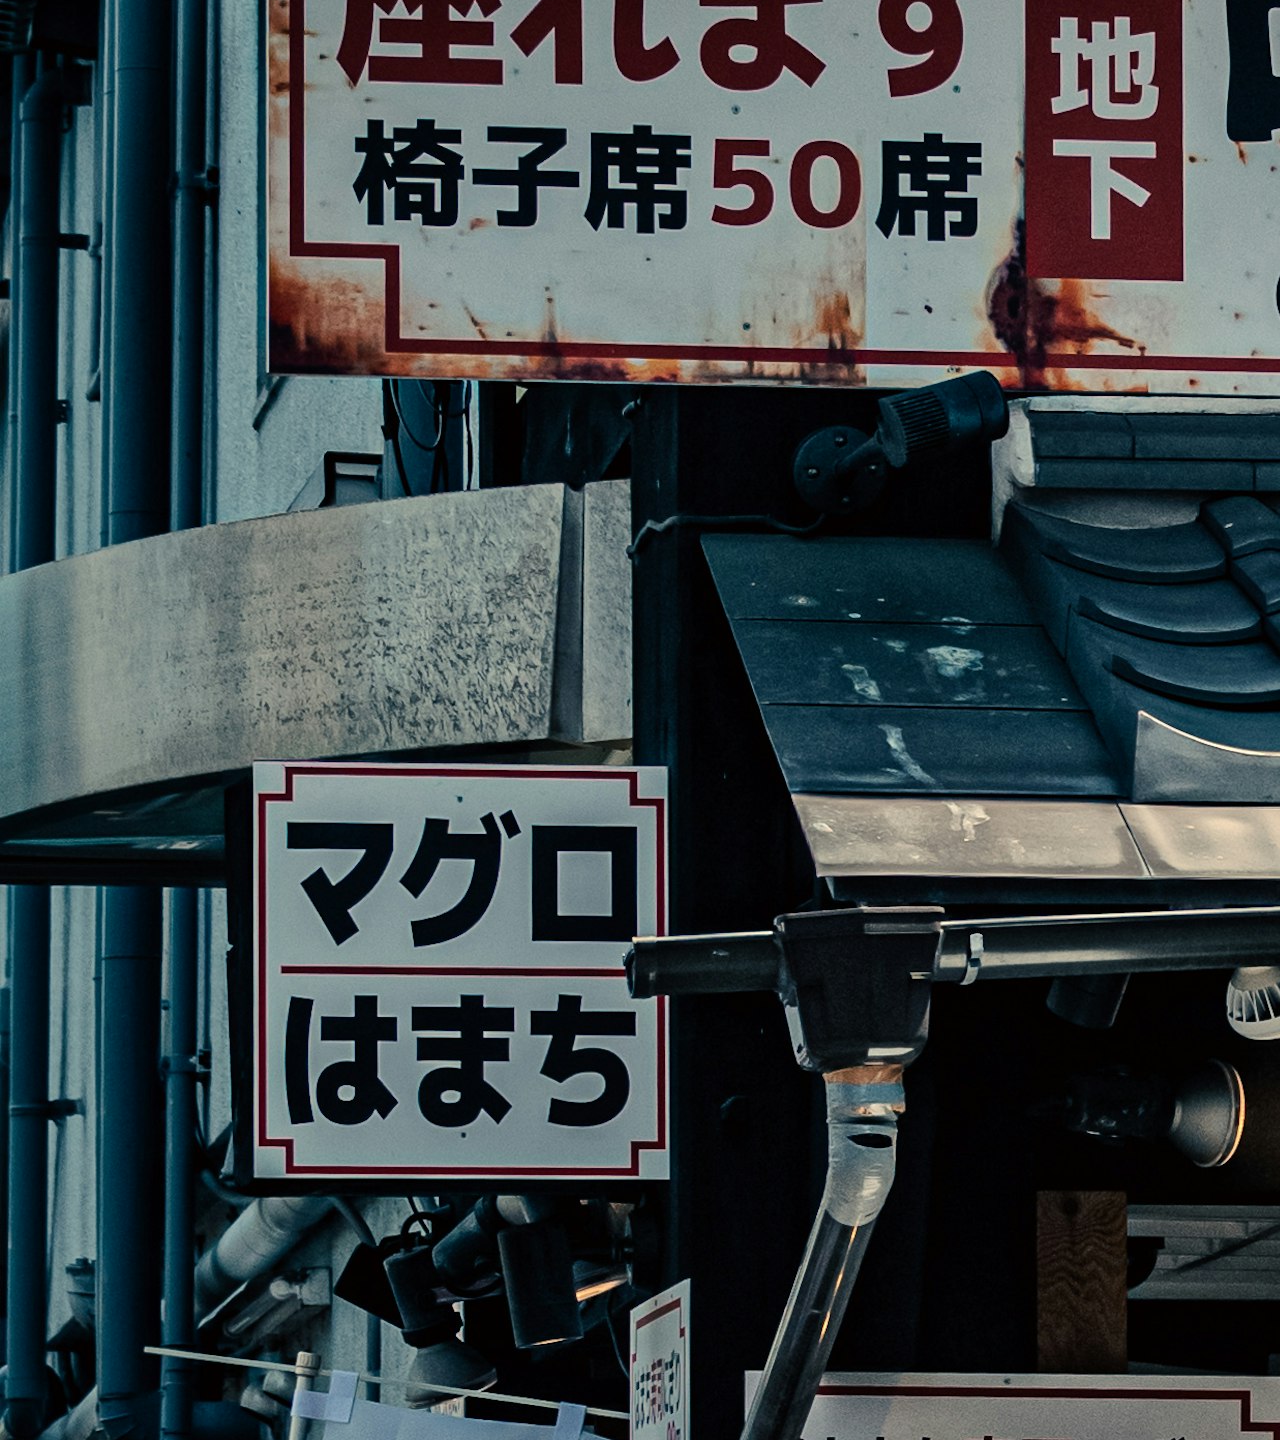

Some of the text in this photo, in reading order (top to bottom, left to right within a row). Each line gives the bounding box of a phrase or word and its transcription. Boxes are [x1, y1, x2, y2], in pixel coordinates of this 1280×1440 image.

[353, 118, 982, 242] 椅子席50席
[287, 809, 638, 947] マグロ
[285, 994, 637, 1127] はまち
